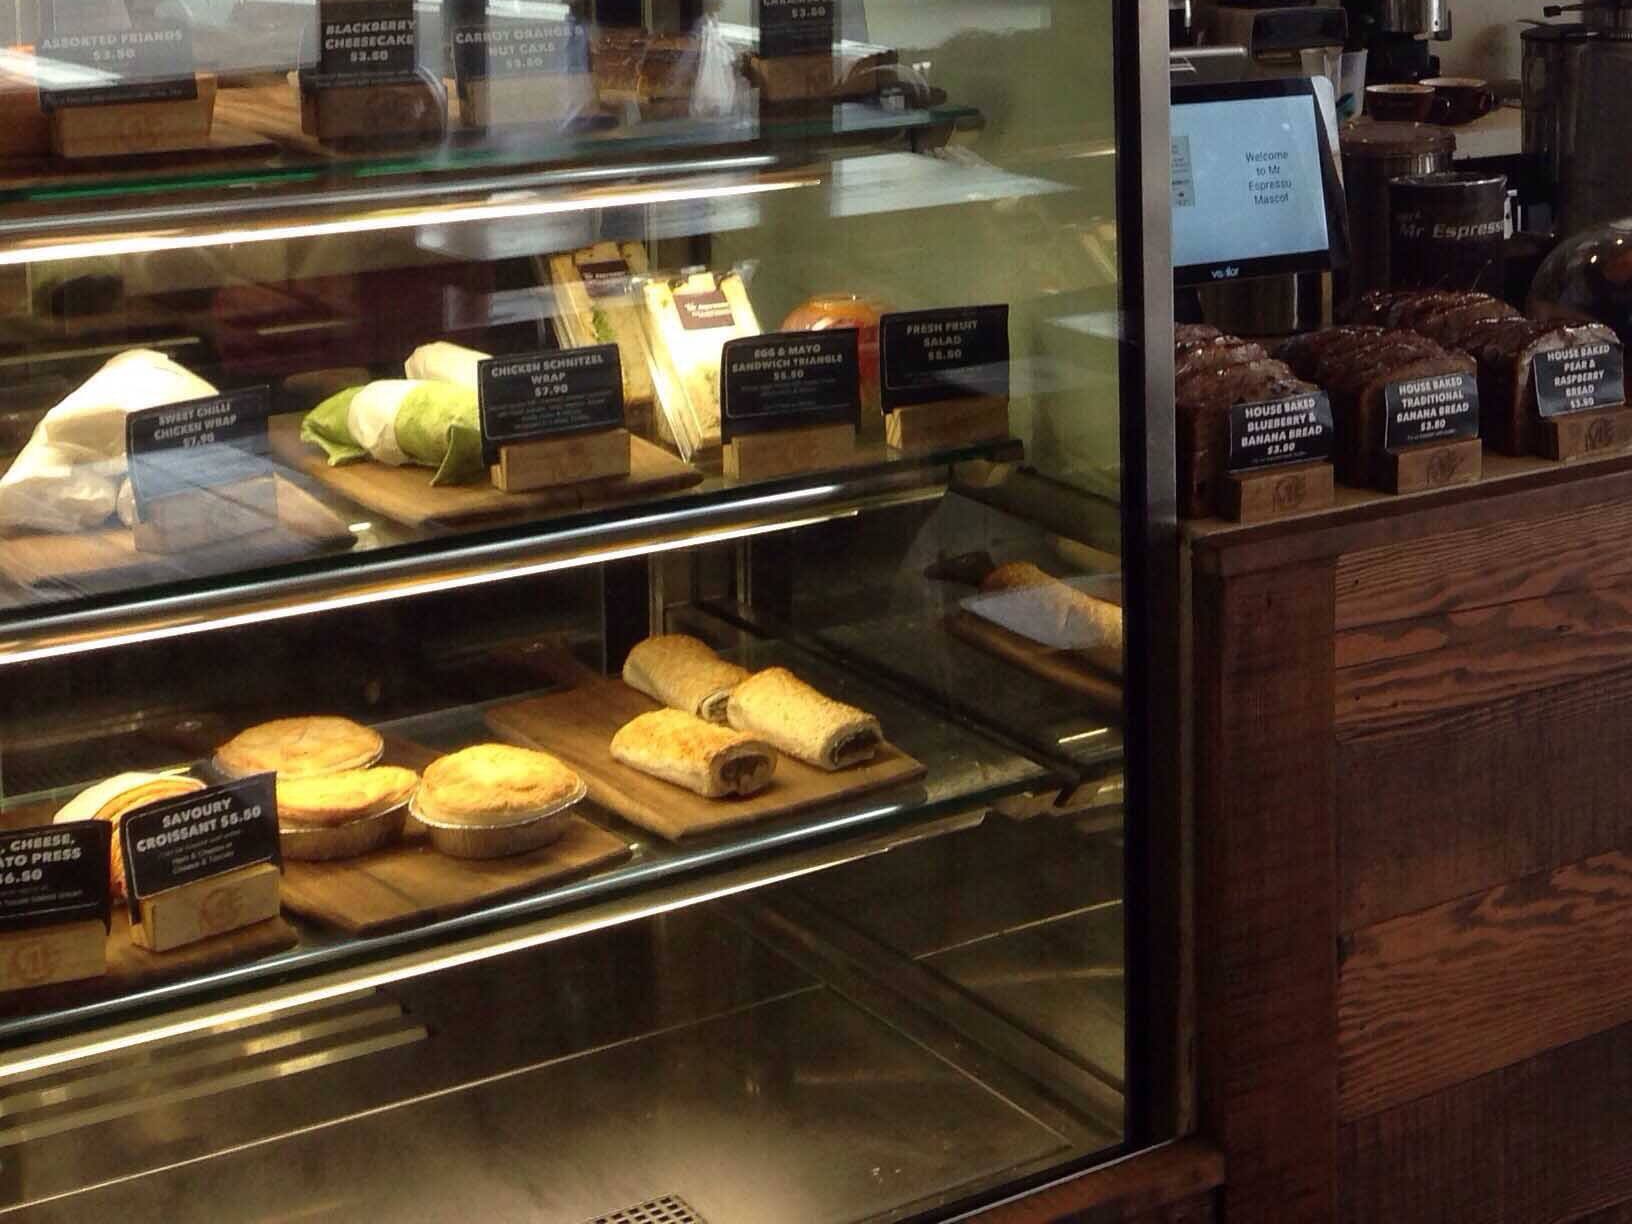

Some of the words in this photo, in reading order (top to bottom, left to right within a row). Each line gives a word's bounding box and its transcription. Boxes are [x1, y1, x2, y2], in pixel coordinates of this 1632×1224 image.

[326, 20, 416, 34] BLACKBERRY
[325, 34, 415, 49] CHEESECAKE
[1245, 151, 1289, 163] Welcome
[1256, 167, 1266, 176] to
[1268, 166, 1280, 175] Mr
[1254, 193, 1289, 205] Mascot
[906, 323, 942, 335] FRESH
[945, 320, 978, 331] FRUIT
[923, 336, 962, 347] SALAD
[754, 347, 775, 359] EGG
[788, 344, 821, 355] MAYO
[1547, 348, 1579, 361] HOUSE
[1581, 344, 1610, 357] BAKED
[491, 362, 540, 378] CHICKEN
[544, 354, 604, 370] SCHNITZEL
[732, 360, 790, 373] SANDWICH
[793, 354, 843, 366] TRIANGLE
[1564, 360, 1587, 372] PEAR
[531, 373, 566, 384] WRAP
[1399, 381, 1432, 395] HOUSE
[1433, 377, 1462, 390] BAKED
[1554, 369, 1604, 386] RASPBERRY
[1401, 390, 1464, 408] TRADITIONAL
[1565, 384, 1594, 398] BREAD
[158, 409, 195, 427] SWEET
[196, 402, 232, 421] CHILLI
[1245, 403, 1282, 418] HOUSE
[1284, 397, 1315, 413] BAKED
[1396, 407, 1437, 423] BANANA
[1439, 402, 1469, 416] BREAD
[154, 422, 202, 442] CHICKEN
[204, 414, 237, 431] WRAP
[1247, 413, 1306, 432] BLUEBERRY
[1241, 431, 1286, 448] BANANA
[1289, 425, 1322, 439] BREAD
[162, 797, 232, 829] SAVOURY
[10, 833, 75, 852] CHEESE,
[136, 819, 218, 853] CROISSANT
[31, 847, 81, 864] PRESS
